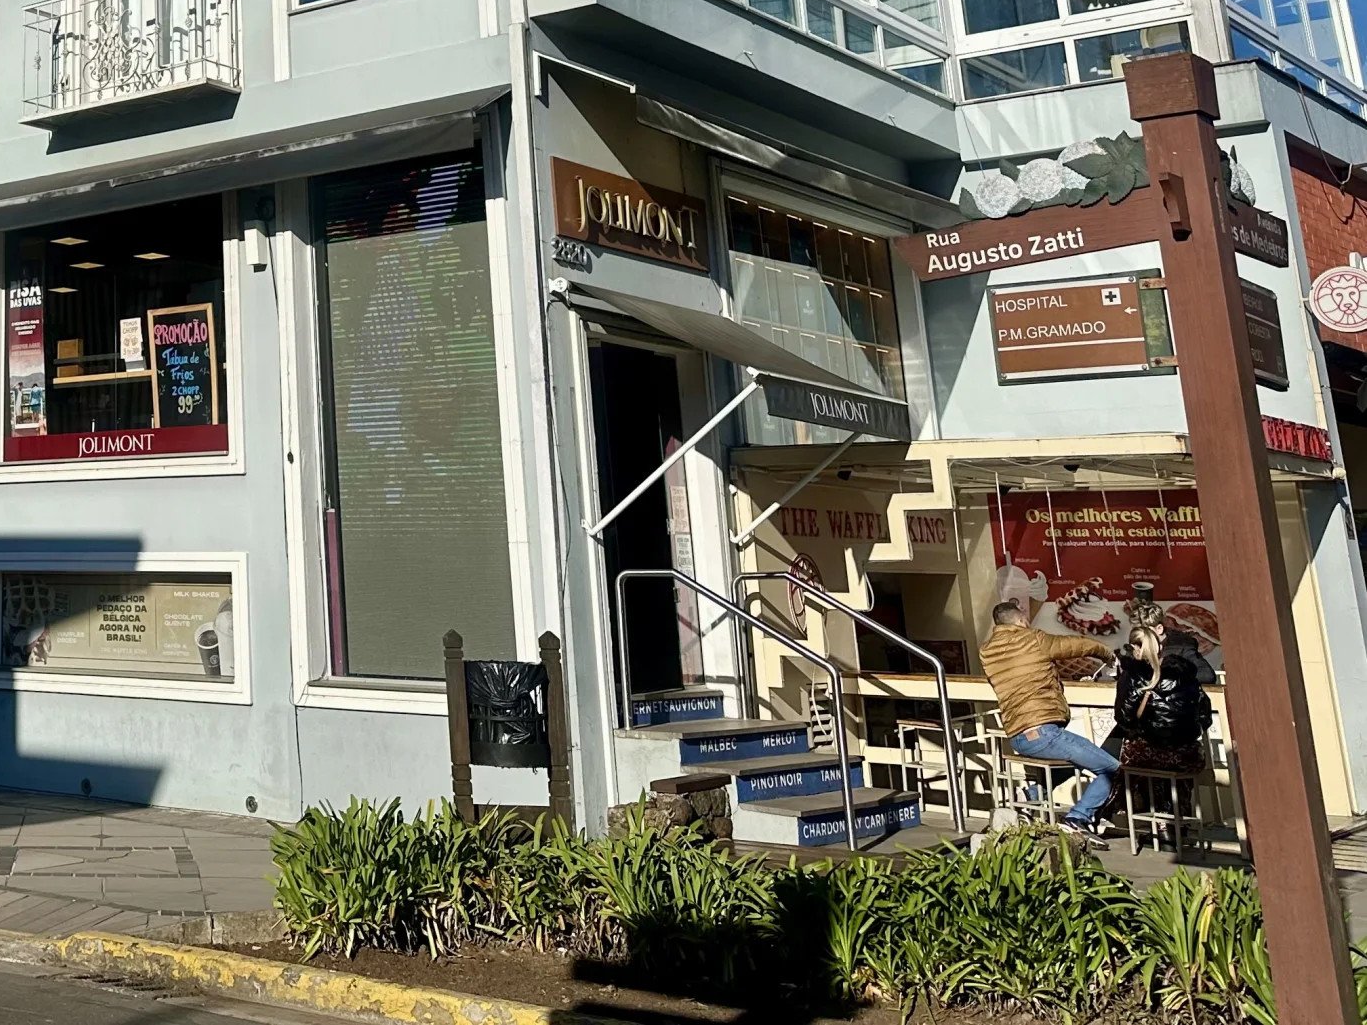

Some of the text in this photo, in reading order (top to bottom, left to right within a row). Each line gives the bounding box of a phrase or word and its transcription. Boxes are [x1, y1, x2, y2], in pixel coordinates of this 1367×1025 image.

[574, 175, 699, 249] JOLIMONT
[926, 230, 960, 249] Rua
[1239, 225, 1251, 246] de
[927, 227, 1084, 274] Augusto Zatti
[995, 294, 1068, 314] HOSPITAL
[154, 319, 208, 346] PROMOÇÃO
[998, 320, 1106, 342] P.M.GRAMADO
[190, 352, 199, 364] de
[170, 366, 194, 381] Frios
[178, 386, 200, 395] CHOPP
[810, 392, 869, 425] JOLIMONT
[78, 433, 155, 458] JOLIMONT
[1025, 506, 1201, 523] Os melhores Waffl
[781, 507, 947, 544] THE WAFFL KING
[1045, 525, 1204, 539] da sua vida estão aqui!
[107, 595, 145, 603] MELHOR
[97, 604, 147, 615] PEDAÇO DA
[103, 612, 140, 622] BÉLGICA
[99, 624, 146, 632] AGORA NO
[106, 634, 142, 642] BRASIL!
[664, 697, 716, 713] SAUVIGNON
[699, 731, 798, 753] MALBEC MERLOT
[750, 769, 842, 791] PINOT NOIR TANN
[803, 817, 862, 839] CHARDONY
